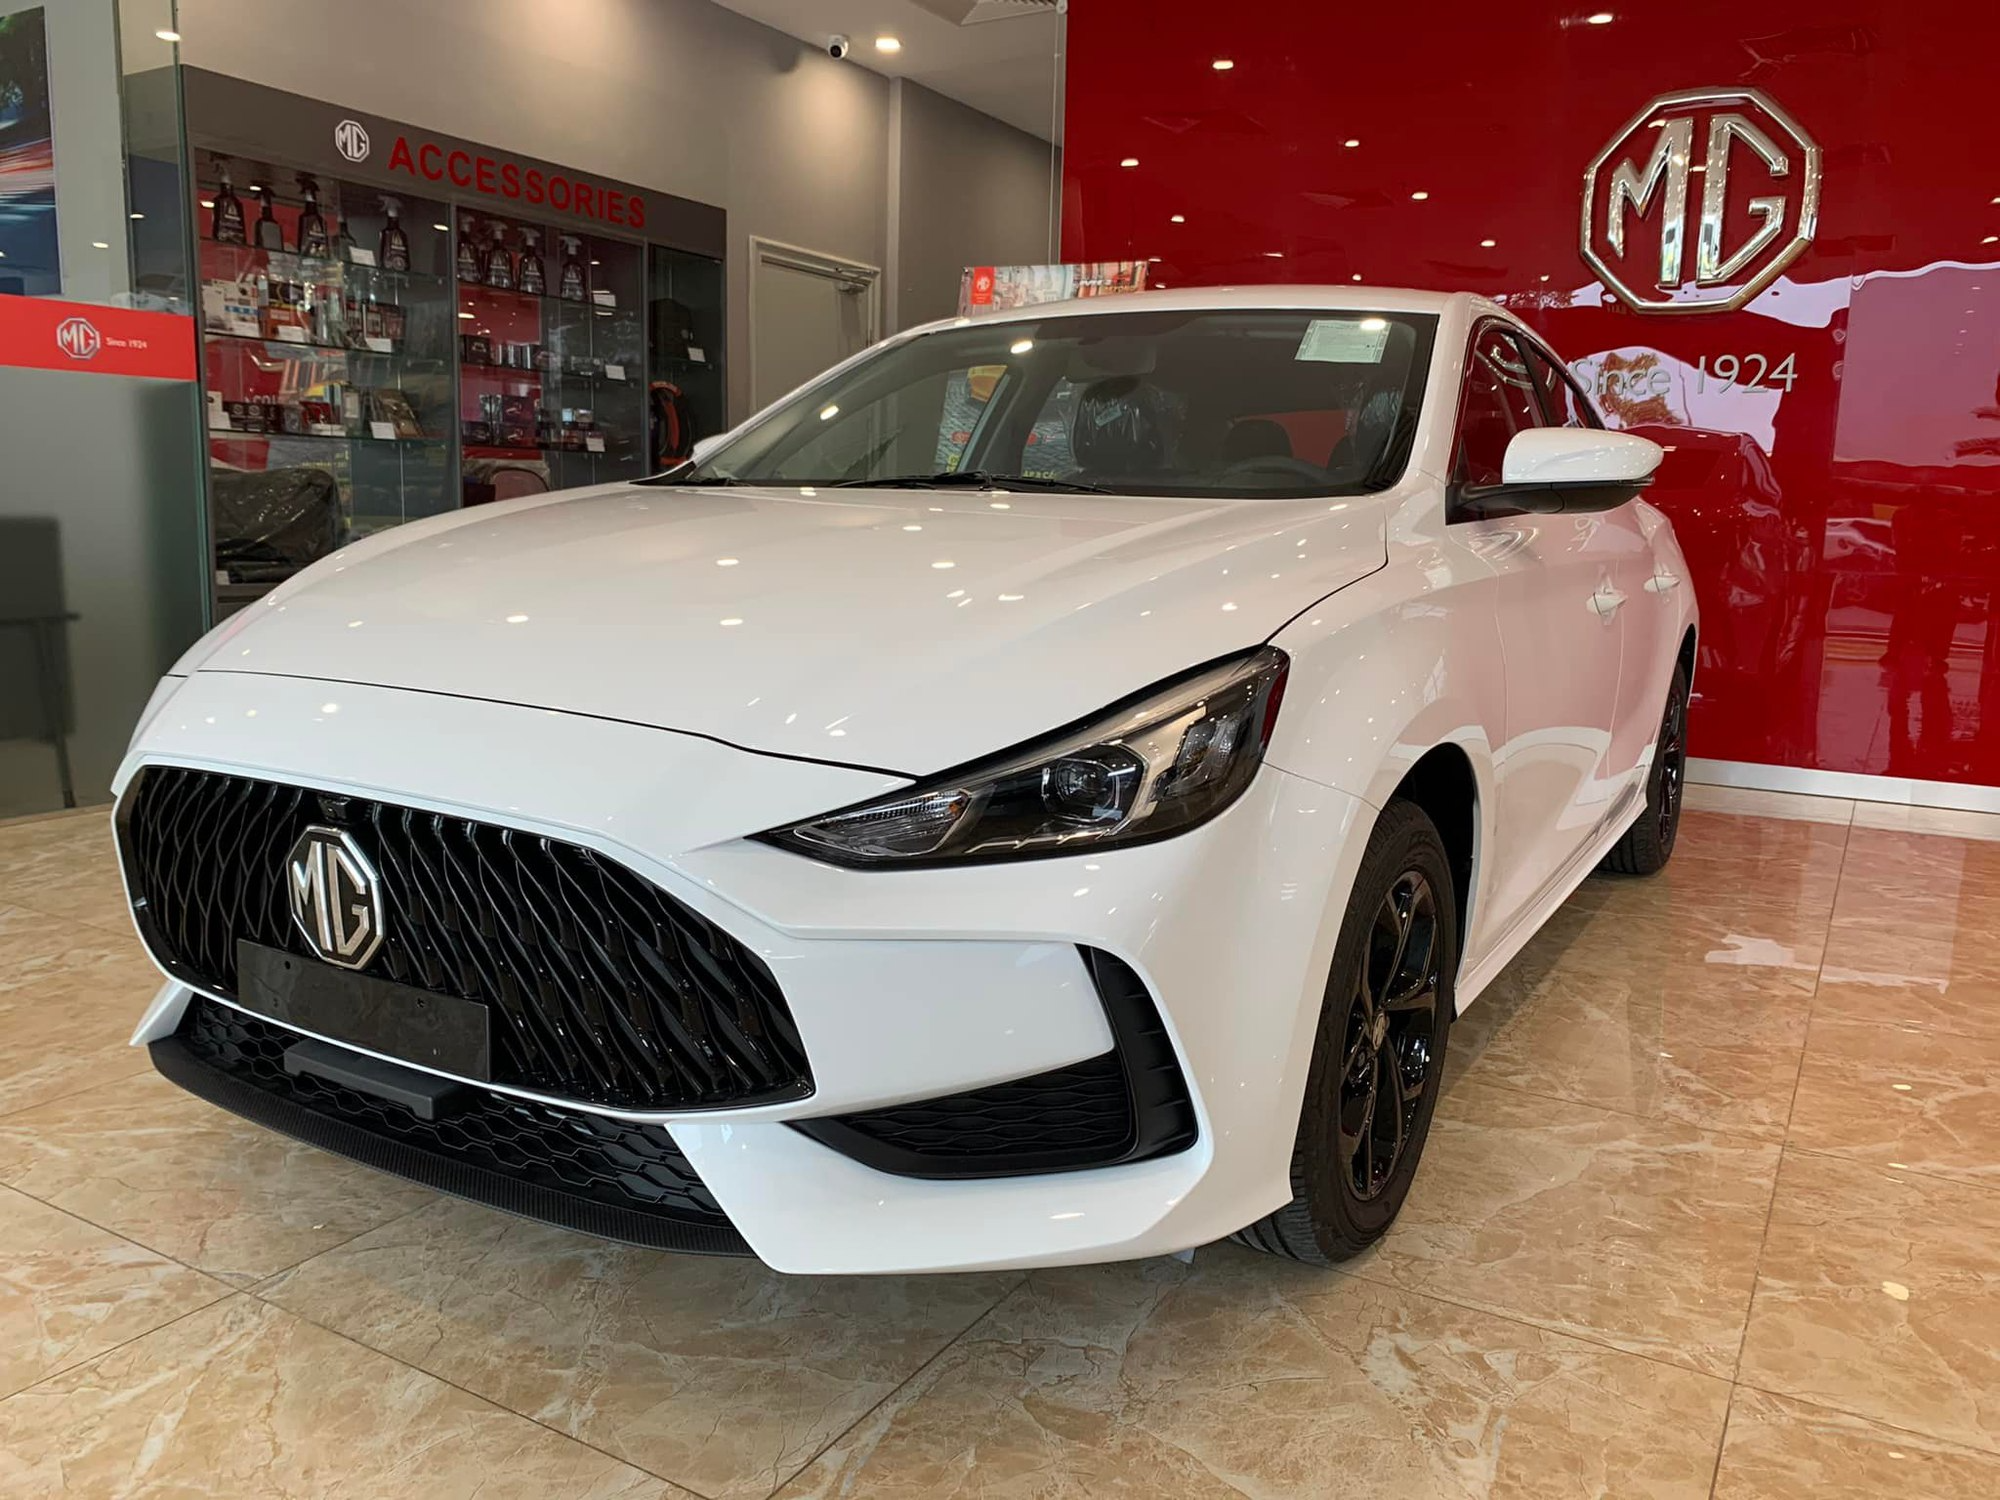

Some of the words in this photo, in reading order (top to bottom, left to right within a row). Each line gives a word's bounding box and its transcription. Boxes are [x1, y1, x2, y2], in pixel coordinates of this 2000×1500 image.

[336, 122, 368, 160] MG
[388, 136, 646, 229] ACCESSORIES
[1606, 113, 1789, 289] MG
[60, 321, 97, 355] MG
[106, 336, 127, 348] Since
[128, 339, 148, 350] 1924
[1570, 356, 1672, 397] Since
[1697, 352, 1799, 395] 1924
[291, 839, 371, 957] MG
